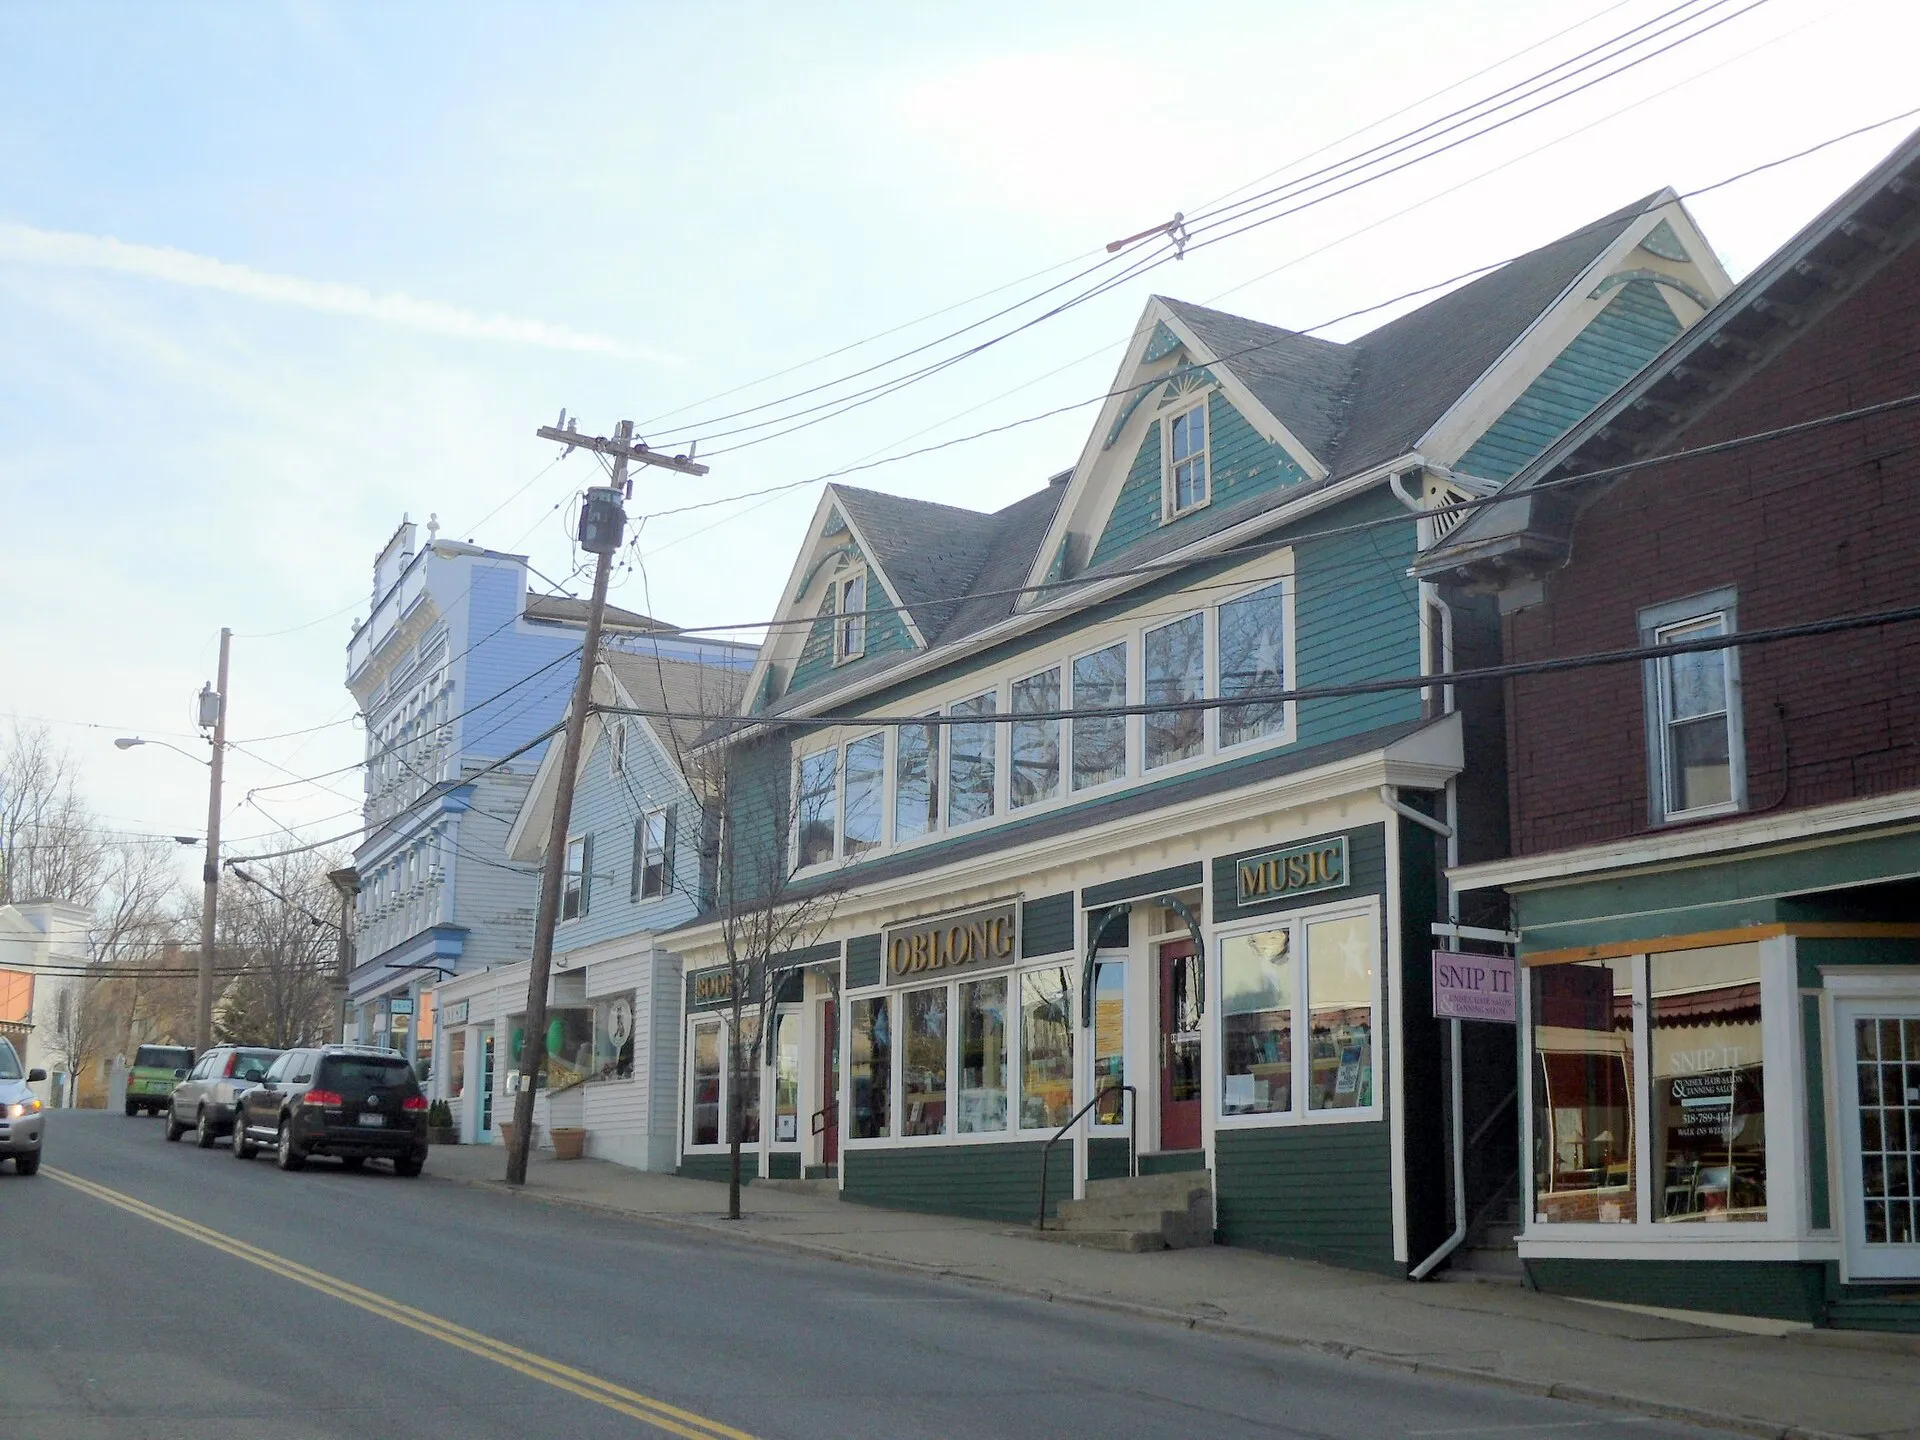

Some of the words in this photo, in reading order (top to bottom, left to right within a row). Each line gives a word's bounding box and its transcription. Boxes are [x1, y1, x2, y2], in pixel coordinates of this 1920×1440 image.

[1240, 847, 1340, 898] MUSIC
[889, 914, 1014, 976] OBLONG
[1440, 965, 1485, 990] SNIP
[1492, 970, 1511, 993] IT
[1440, 994, 1459, 1014] &
[1456, 1003, 1484, 1013] TANNING
[1485, 1006, 1506, 1016] SALON
[1491, 997, 1512, 1008] SALON
[1671, 1048, 1716, 1074] SNIP
[1723, 1046, 1743, 1068] IT
[1672, 1079, 1688, 1098] &
[1686, 1085, 1715, 1096] TANNING
[1704, 1077, 1721, 1086] HAIR
